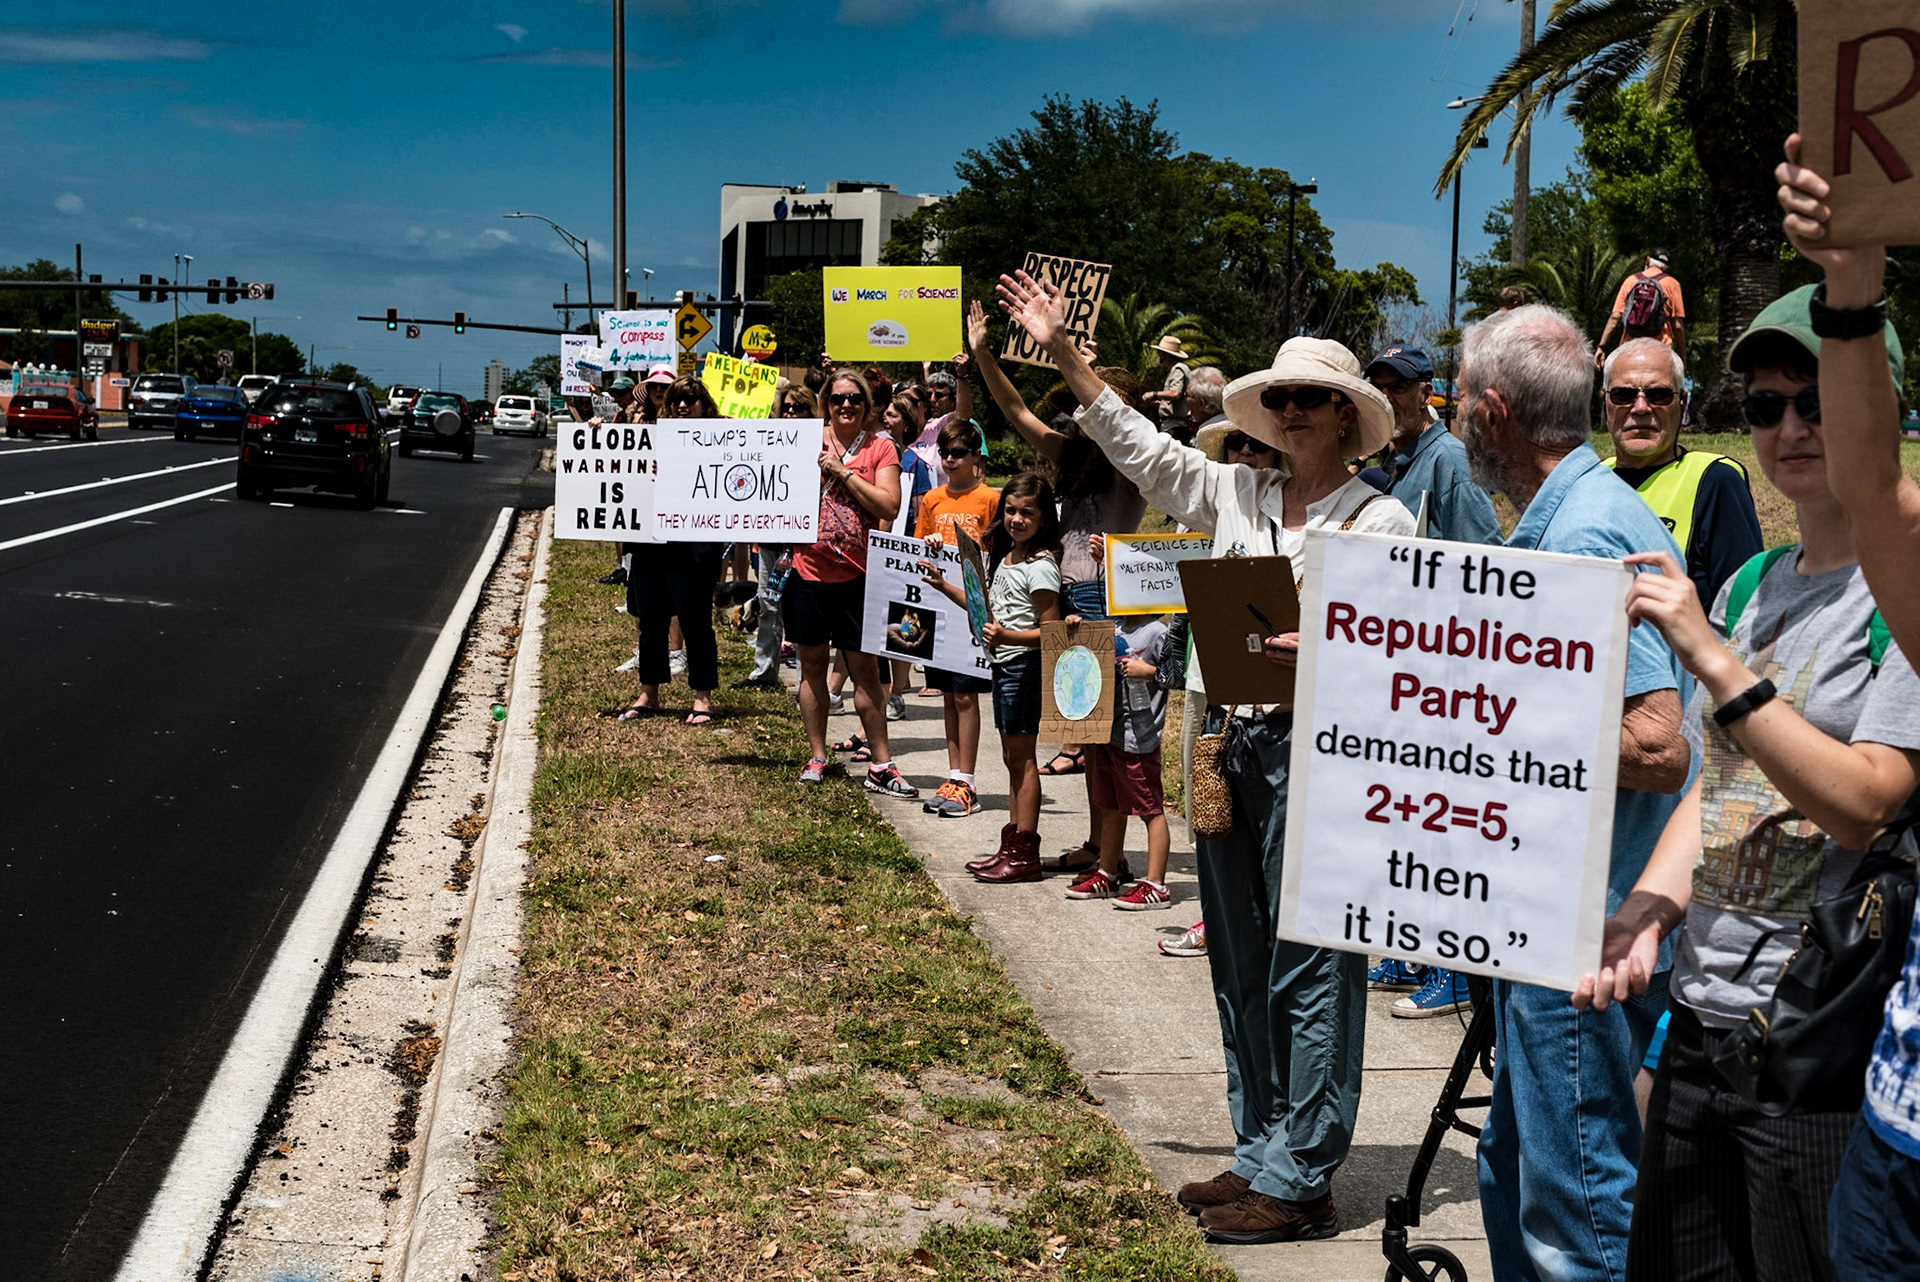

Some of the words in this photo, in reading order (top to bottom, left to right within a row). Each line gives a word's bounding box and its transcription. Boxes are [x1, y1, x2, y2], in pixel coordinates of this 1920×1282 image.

[1020, 253, 1110, 302] RESPECT
[832, 290, 848, 301] WE
[857, 288, 887, 300] MARCH
[898, 288, 914, 300] FOR
[917, 286, 959, 299] SCIENCE!
[81, 320, 116, 330] Budget
[87, 329, 109, 338] INN
[609, 348, 622, 366] 4
[680, 354, 695, 364] 25
[573, 428, 653, 450] GLOBA
[678, 429, 747, 447] TRUMP'S
[757, 430, 799, 447] TEAM
[723, 452, 732, 461] IS
[740, 452, 763, 461] LIKE
[600, 482, 624, 503] IS
[691, 463, 790, 501] ATOMS
[576, 507, 641, 530] REAL
[657, 513, 688, 528] THEY
[691, 514, 721, 529] MAKE
[725, 514, 740, 529] UP
[743, 514, 810, 530] EVERYTHING
[870, 535, 921, 556] THERE
[924, 546, 939, 559] IS
[1130, 539, 1188, 553] SCIENCE
[1389, 546, 1445, 590] “If
[1460, 555, 1537, 599] the
[904, 583, 922, 604] B
[1326, 601, 1594, 673] Republican
[1391, 672, 1517, 735] Party
[1047, 707, 1104, 740] SHIP
[1315, 724, 1495, 778] demands
[1508, 750, 1588, 792] that
[1365, 784, 1520, 851] 2+2=5,
[1387, 850, 1489, 902] then
[1344, 903, 1372, 943] it
[1386, 910, 1421, 951] is
[1436, 928, 1528, 967] so.”
